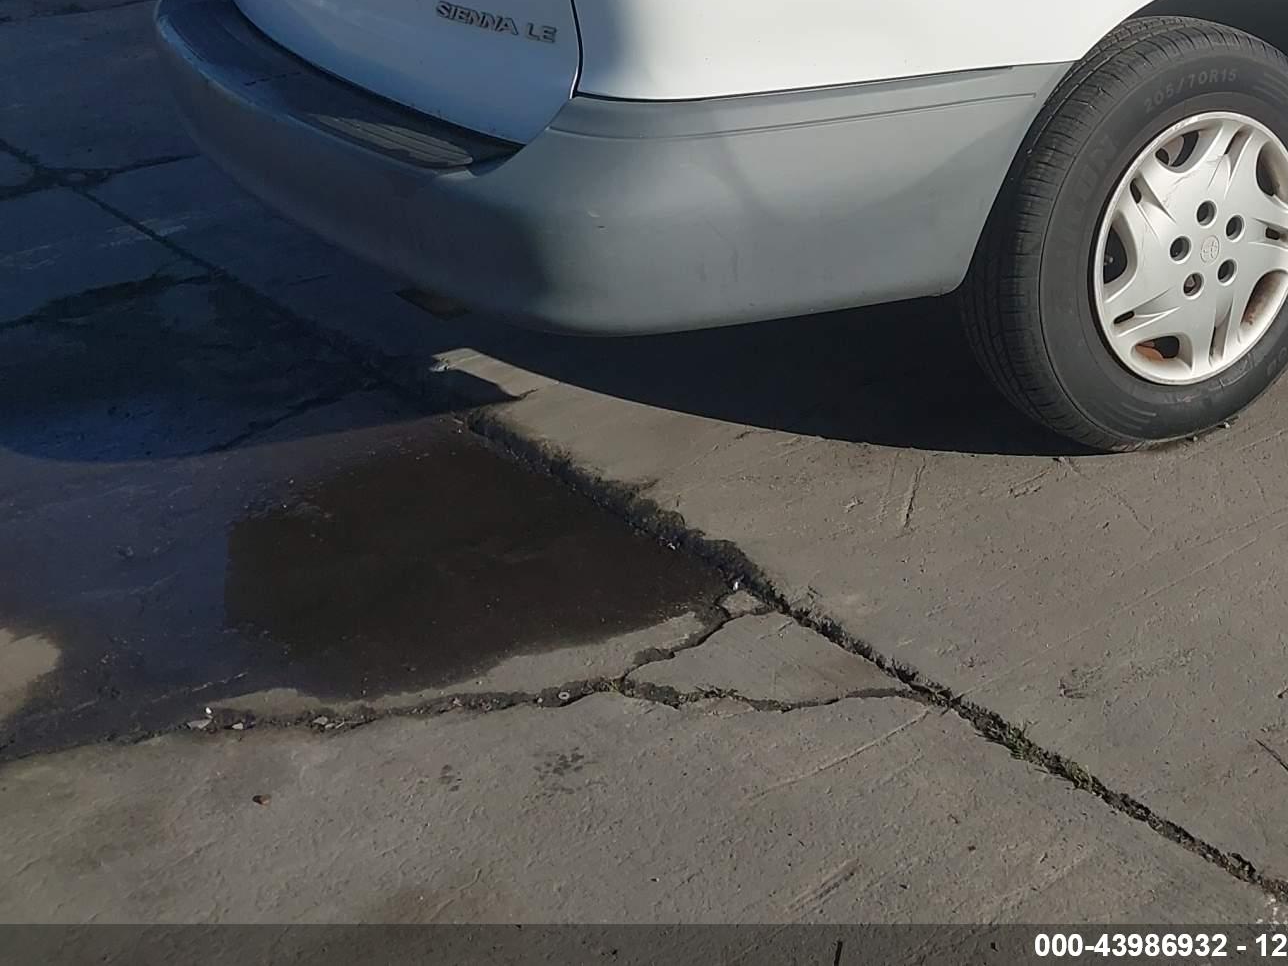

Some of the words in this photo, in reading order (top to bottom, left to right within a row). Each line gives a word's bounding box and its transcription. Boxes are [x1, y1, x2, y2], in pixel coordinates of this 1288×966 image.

[437, 0, 519, 36] SIENNA
[527, 22, 558, 44] LE
[1144, 68, 1239, 114] 205/70R15
